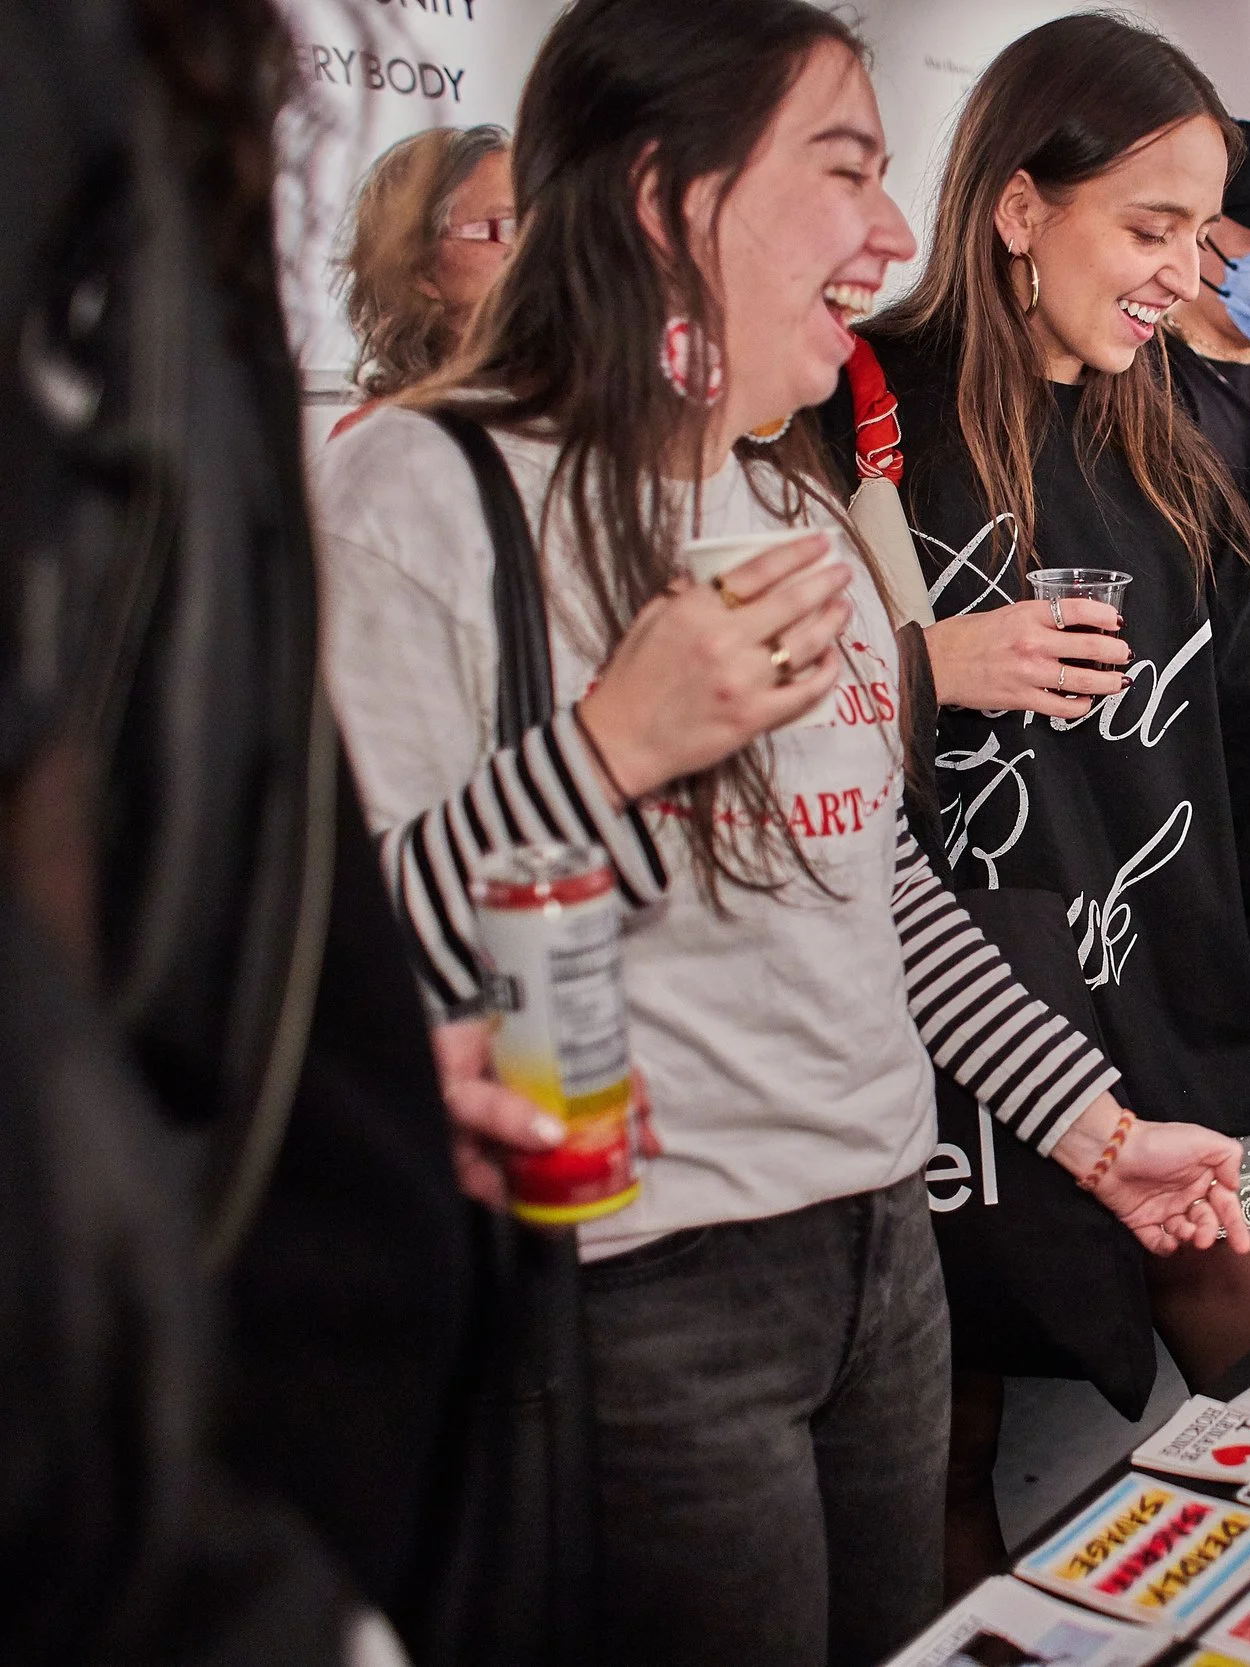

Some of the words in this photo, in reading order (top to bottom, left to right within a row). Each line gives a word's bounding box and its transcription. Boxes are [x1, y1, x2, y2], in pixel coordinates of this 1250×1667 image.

[363, 52, 465, 103] BODY
[787, 787, 865, 838] ART
[925, 1098, 999, 1213] el
